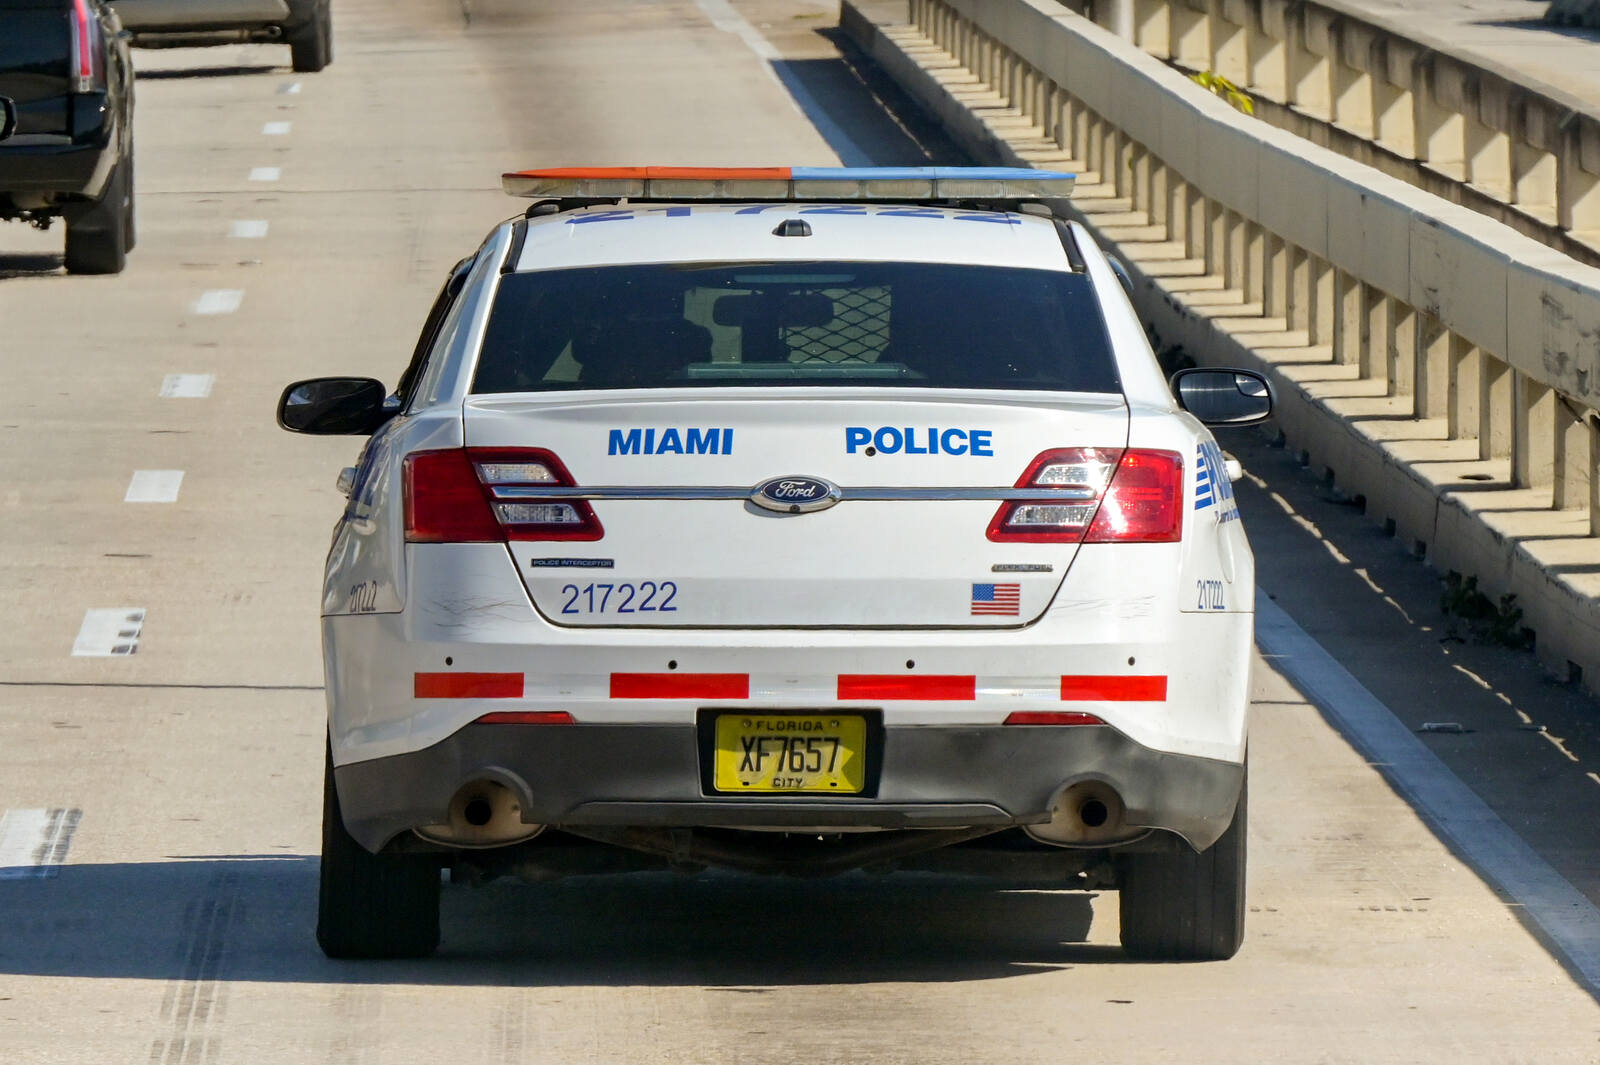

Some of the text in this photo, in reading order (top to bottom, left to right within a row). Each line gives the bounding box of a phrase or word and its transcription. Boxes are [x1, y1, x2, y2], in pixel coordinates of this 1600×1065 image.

[608, 428, 734, 456] MIAMI
[845, 426, 994, 457] POLICE
[775, 480, 816, 499] Ford
[533, 559, 613, 567] POLICE INTERCEPTOR
[561, 581, 678, 614] 217222
[756, 719, 824, 732] FLORIDA
[739, 736, 841, 773] XF7657
[773, 777, 804, 788] CITY
